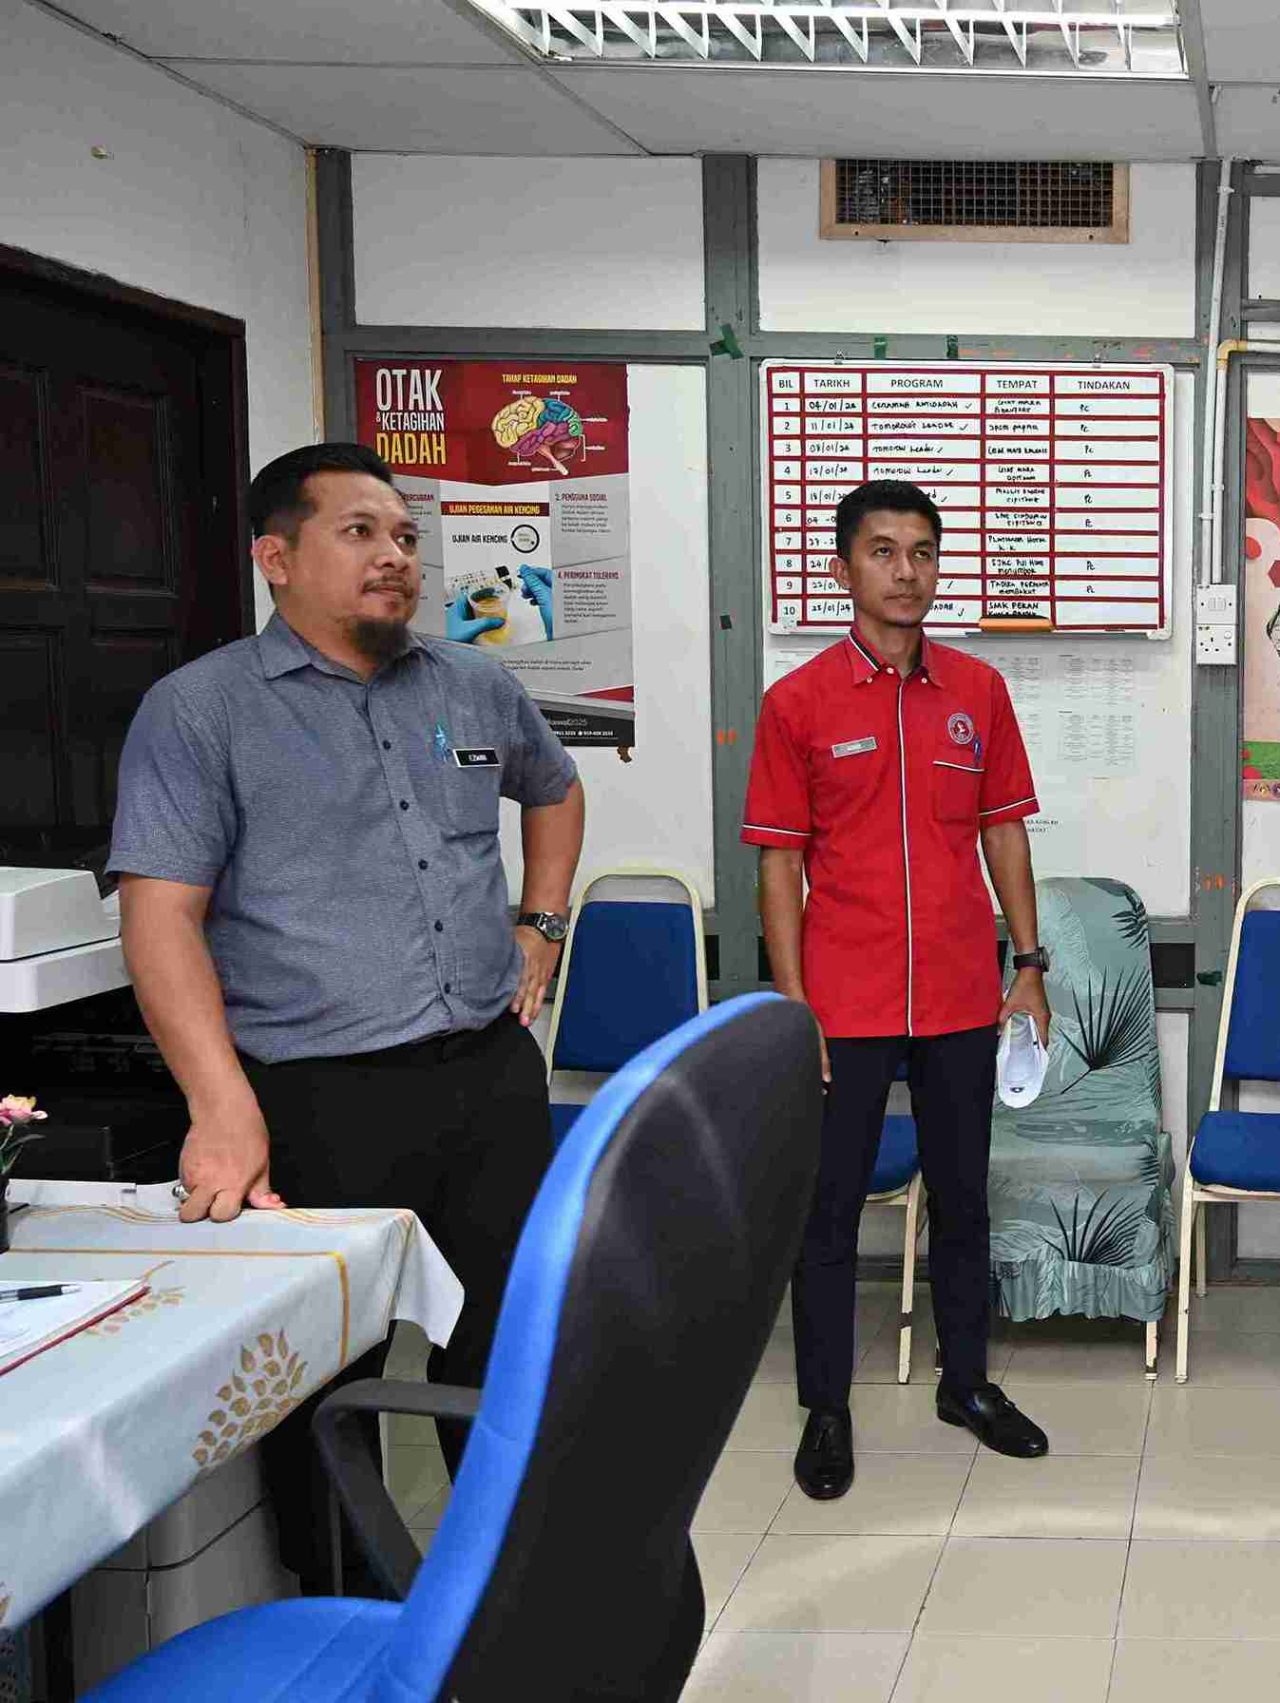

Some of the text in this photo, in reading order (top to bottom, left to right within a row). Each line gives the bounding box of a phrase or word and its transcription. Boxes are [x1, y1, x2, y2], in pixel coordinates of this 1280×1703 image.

[376, 368, 443, 411] OTAK
[778, 378, 1131, 391] BIL TARIKH PROGRAM TEMPAT TINDAKAN
[784, 402, 790, 411] 1
[376, 411, 444, 431] & KETAGIHAN
[376, 432, 447, 465] DADAH
[785, 489, 792, 499] 5
[785, 513, 792, 523] 6
[452, 534, 470, 543] UJIAN
[471, 534, 482, 543] AIR
[483, 535, 508, 543] KENCING
[785, 537, 791, 546] 7
[786, 559, 793, 568] 8
[786, 581, 793, 590] 9
[783, 606, 796, 616] 10
